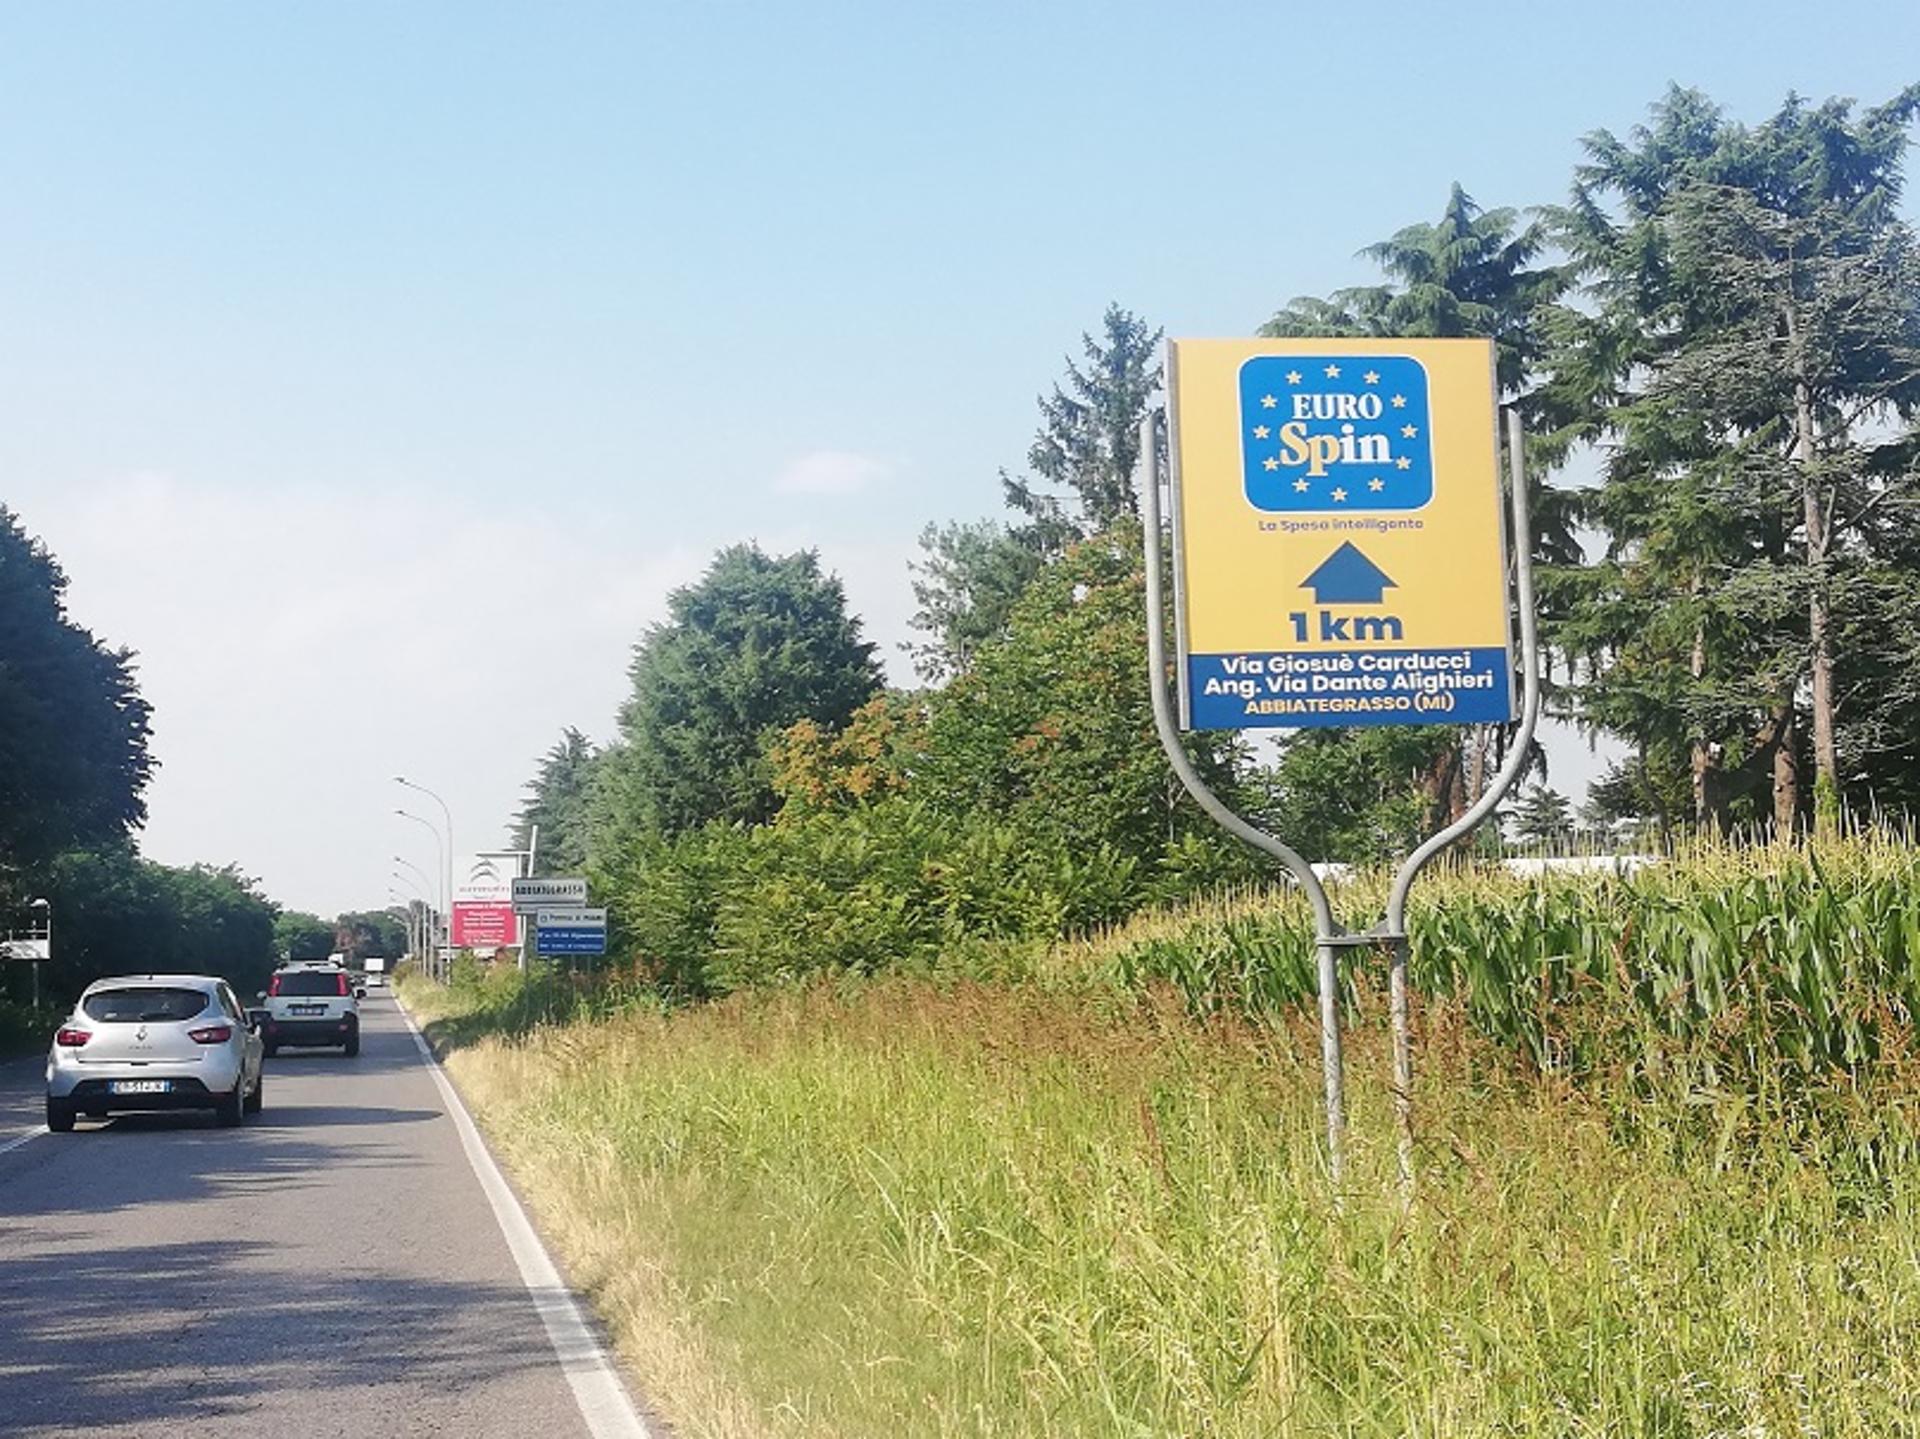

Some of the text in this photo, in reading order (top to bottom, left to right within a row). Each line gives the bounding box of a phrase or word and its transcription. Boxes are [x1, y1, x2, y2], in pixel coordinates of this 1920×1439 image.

[1292, 392, 1383, 420] EURO
[1279, 421, 1393, 476] Spin
[1258, 520, 1277, 531] La
[1280, 520, 1329, 533] Spesa
[1289, 611, 1404, 642] 1 km
[1221, 651, 1471, 674] Via Giosuè Carducci
[1204, 669, 1494, 699] Ang. Via Dante Alighieri
[1244, 691, 1455, 714] ABBIATEGRASSO (MI)
